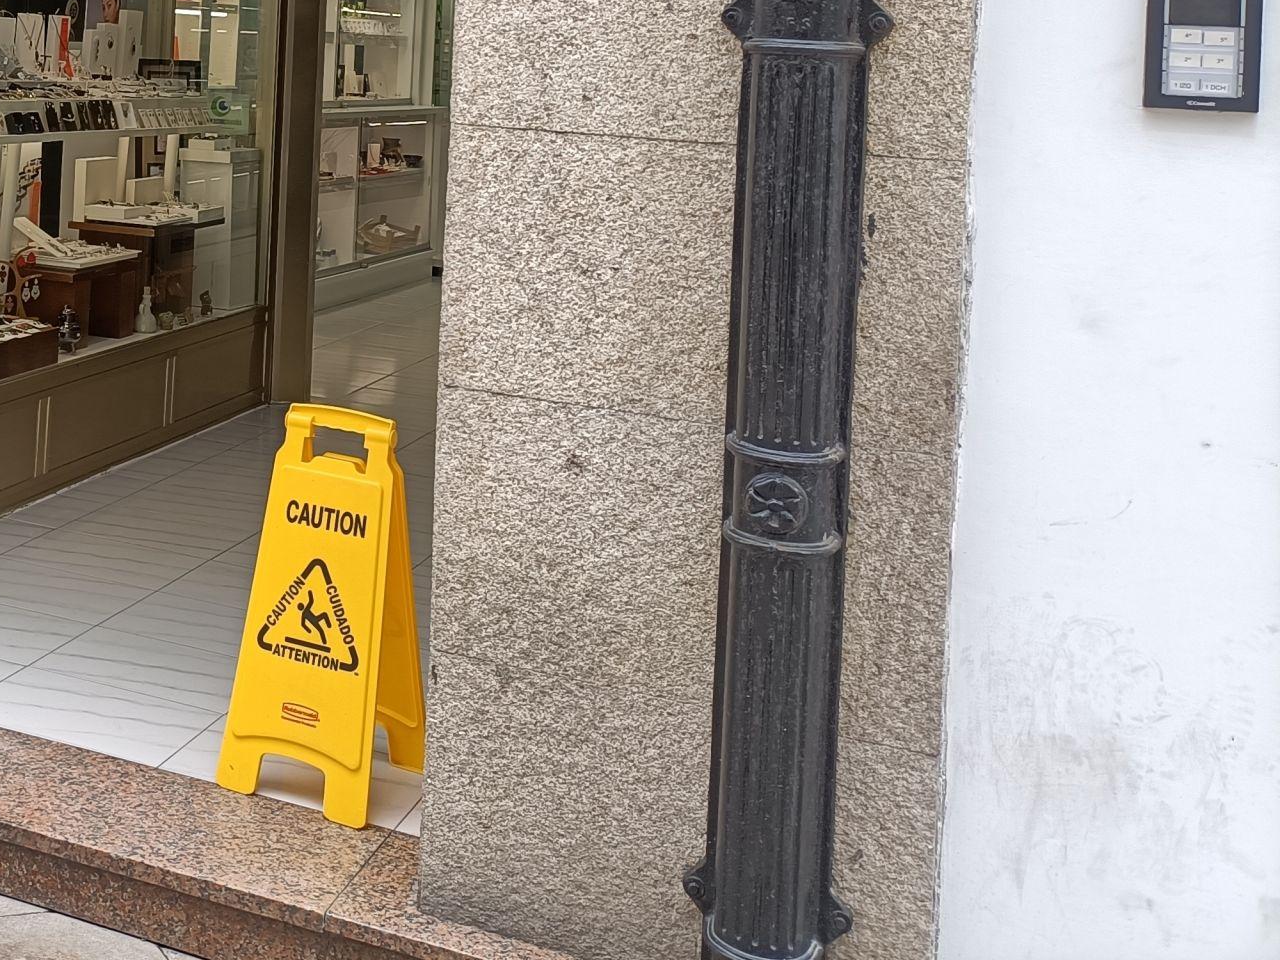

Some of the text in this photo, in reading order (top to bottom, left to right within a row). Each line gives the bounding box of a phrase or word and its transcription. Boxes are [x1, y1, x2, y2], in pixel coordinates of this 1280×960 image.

[286, 500, 367, 539] CAUTION
[266, 575, 306, 627] CAUTION
[325, 584, 355, 645] CUIDADO
[272, 644, 339, 672] ATTENTION
